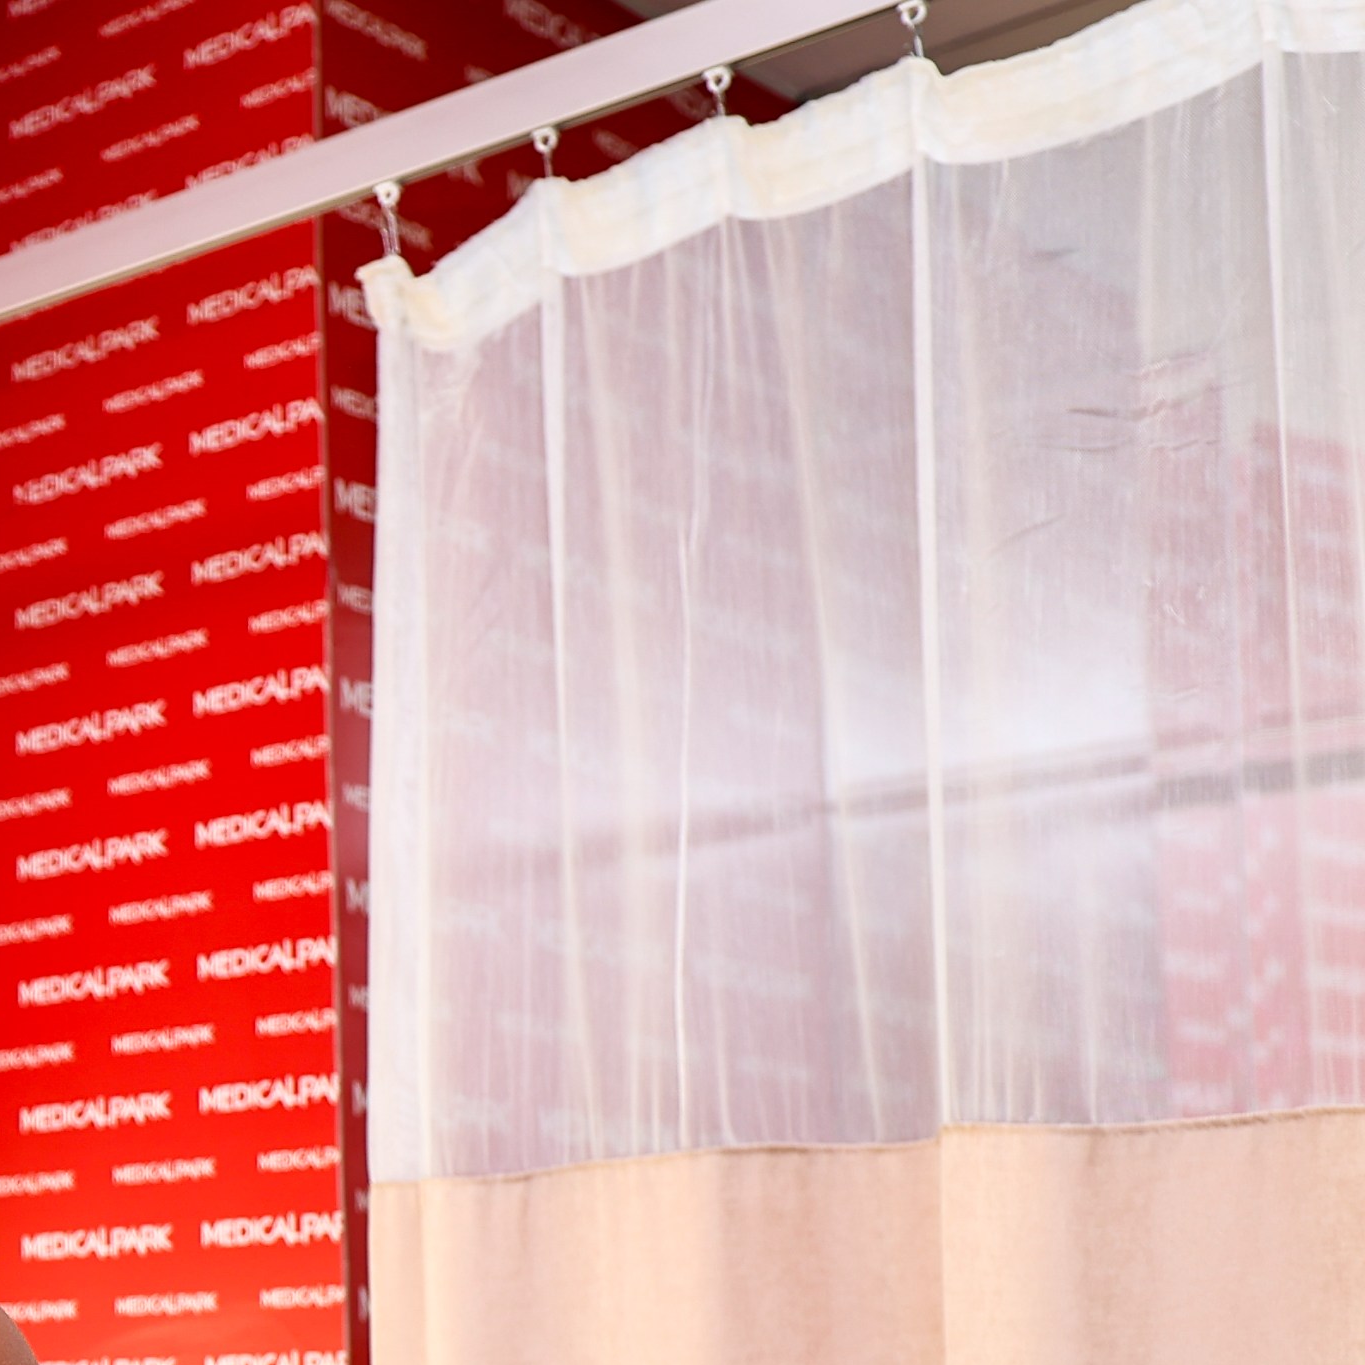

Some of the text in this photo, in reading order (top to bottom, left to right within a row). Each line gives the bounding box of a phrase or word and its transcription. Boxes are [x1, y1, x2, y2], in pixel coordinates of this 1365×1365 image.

[187, 264, 318, 326] MEDICALPA
[189, 397, 325, 456] MEDICALPA
[191, 530, 329, 584] MEDICALPA
[192, 663, 330, 717] MEDICALPA
[195, 800, 334, 848] MEDICALPA
[197, 934, 338, 981] MEDICALPA
[17, 958, 170, 1006] MEDICALPARK
[19, 1090, 172, 1133] MEDICALPARK
[20, 1222, 173, 1261] MEDICALPARK
